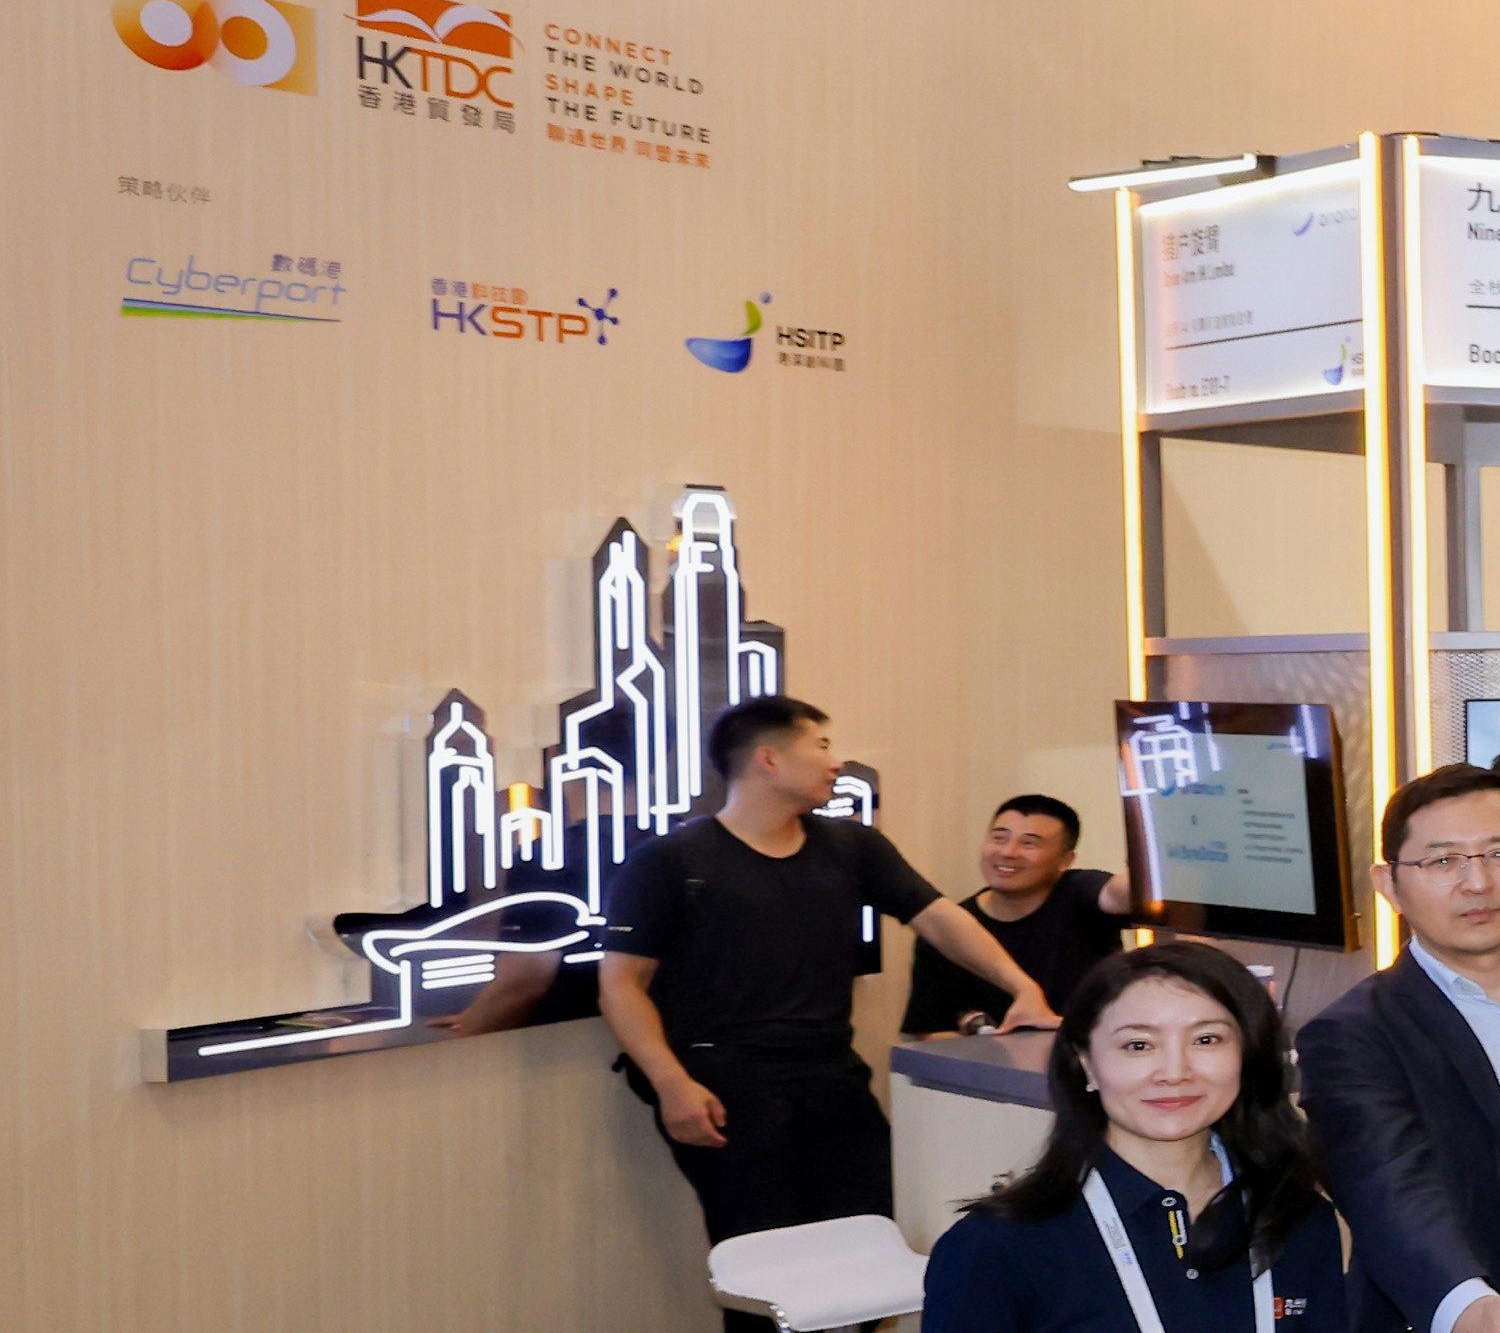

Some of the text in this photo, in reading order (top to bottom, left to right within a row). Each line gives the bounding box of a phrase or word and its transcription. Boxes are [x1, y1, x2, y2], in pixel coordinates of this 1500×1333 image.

[543, 23, 673, 67] CONNECT
[356, 35, 514, 109] HKTDC
[545, 46, 705, 97] THE WORLD
[545, 73, 635, 107] SHAPE
[546, 96, 712, 146] THE FUTURE
[126, 254, 348, 312] Cyberport
[431, 298, 590, 345] HKSTP
[776, 325, 847, 351] HSITP
